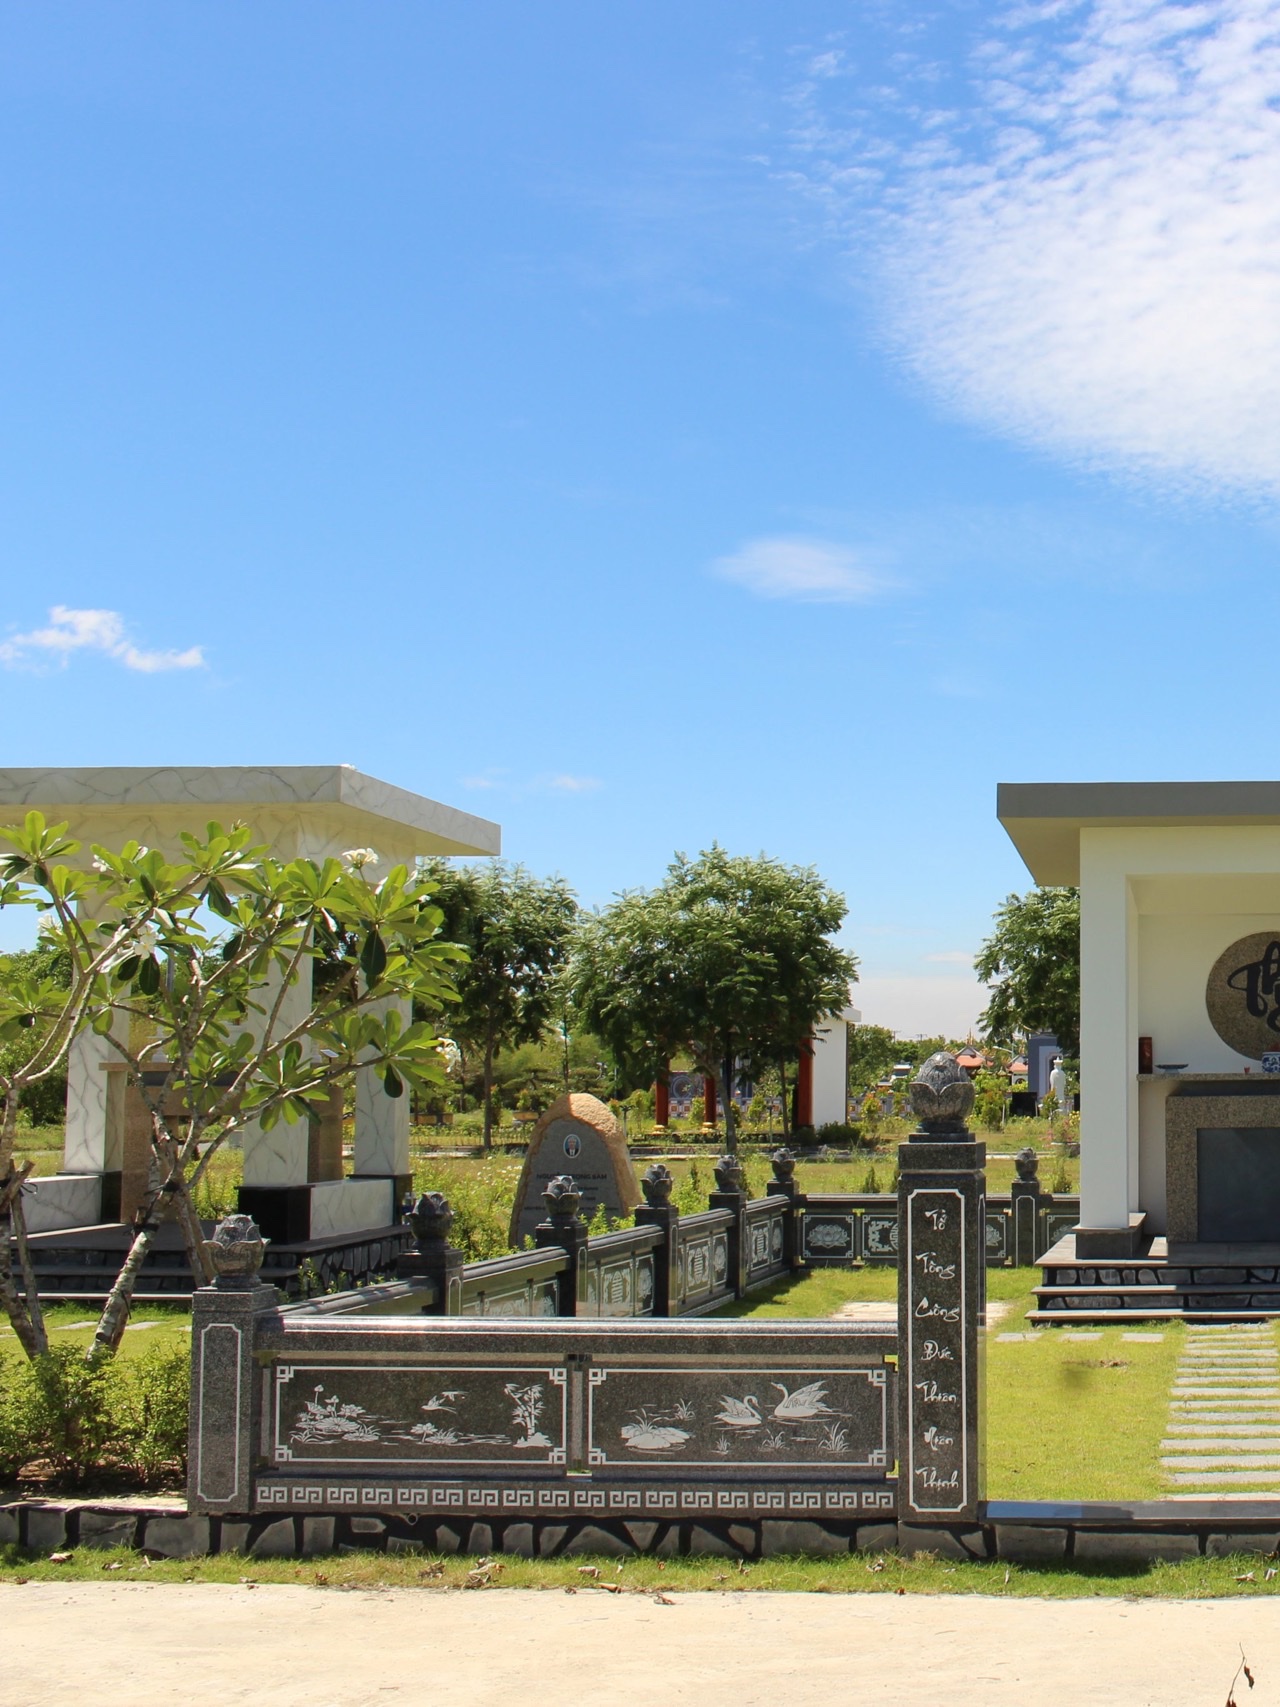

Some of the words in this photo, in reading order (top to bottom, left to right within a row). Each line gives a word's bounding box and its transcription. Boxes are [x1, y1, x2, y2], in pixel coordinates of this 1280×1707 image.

[924, 1209, 947, 1231] Tổ
[914, 1296, 960, 1322] Công
[920, 1339, 954, 1361] Đức
